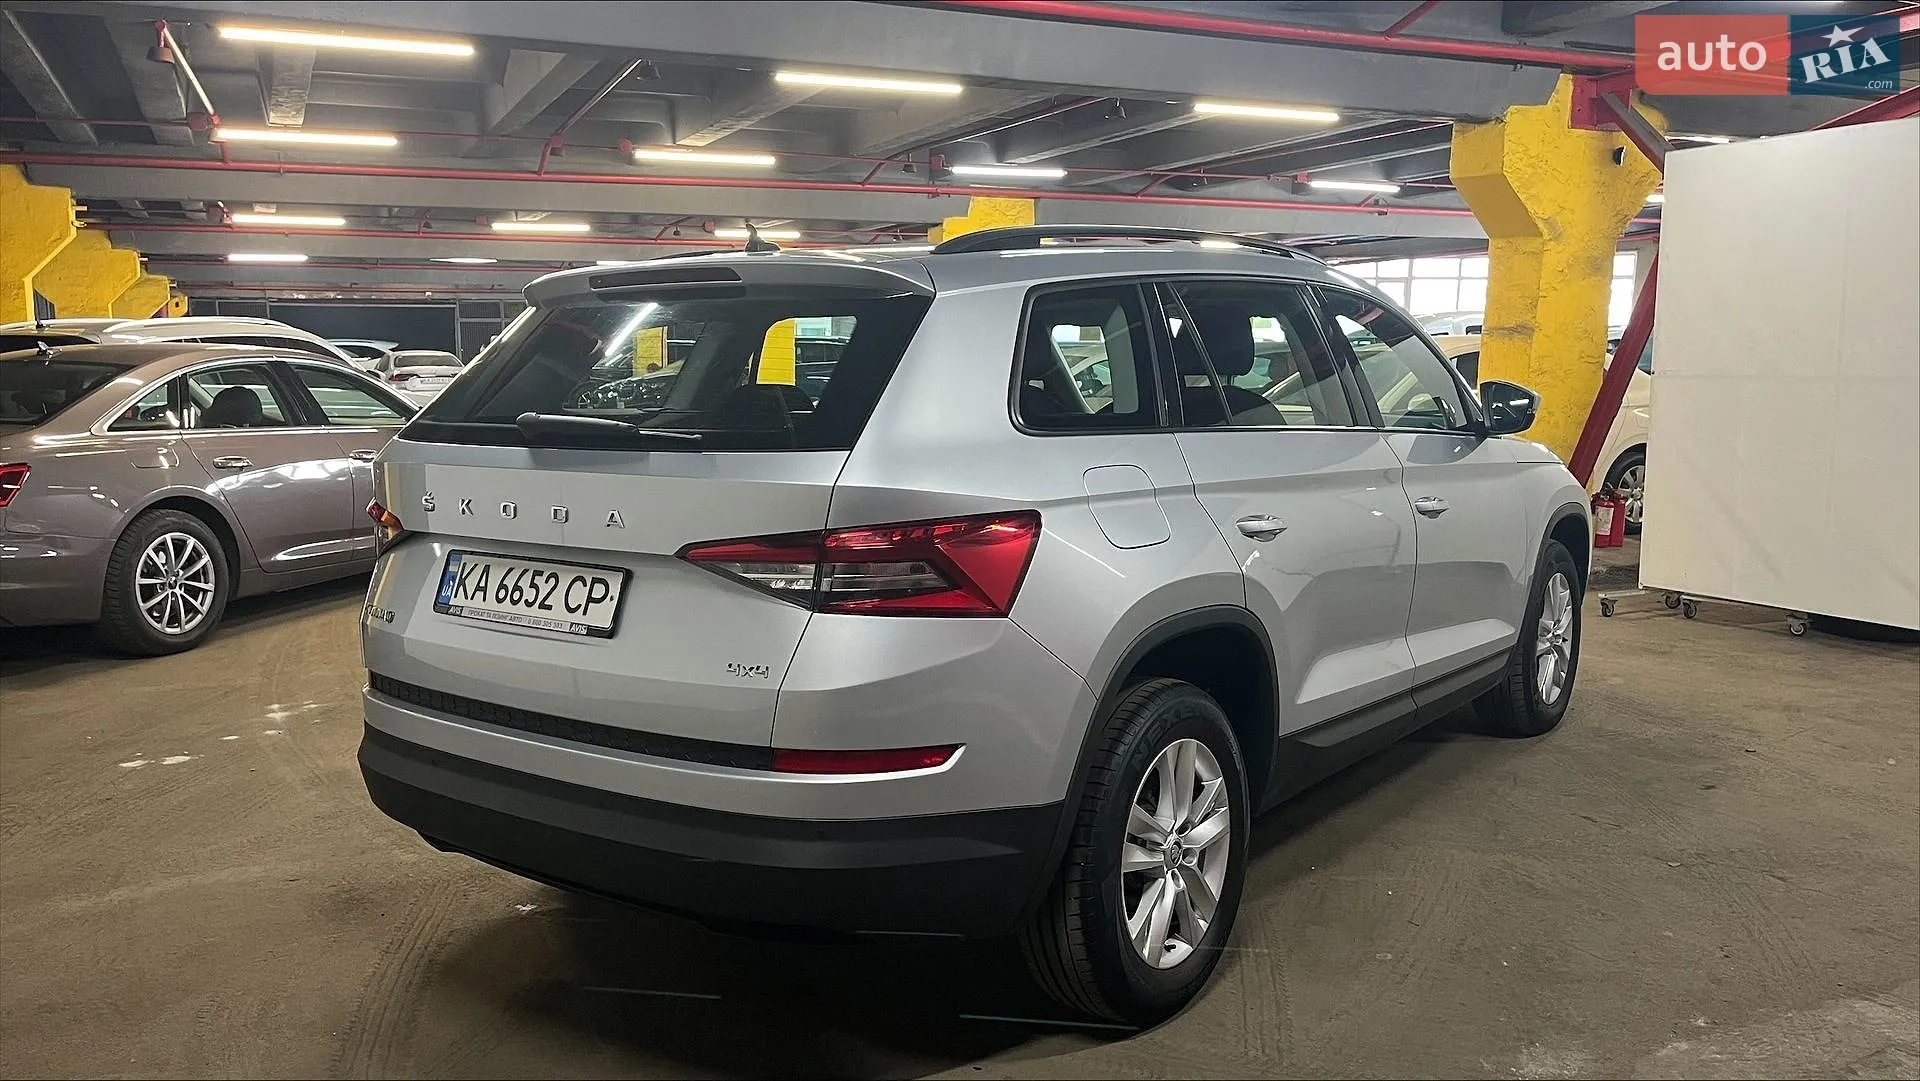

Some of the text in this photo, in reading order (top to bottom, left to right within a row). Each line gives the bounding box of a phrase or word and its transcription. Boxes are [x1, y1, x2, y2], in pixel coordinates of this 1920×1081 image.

[442, 584, 452, 597] UA
[454, 562, 609, 616] KA 6652 CP
[570, 622, 587, 634] AVIS
